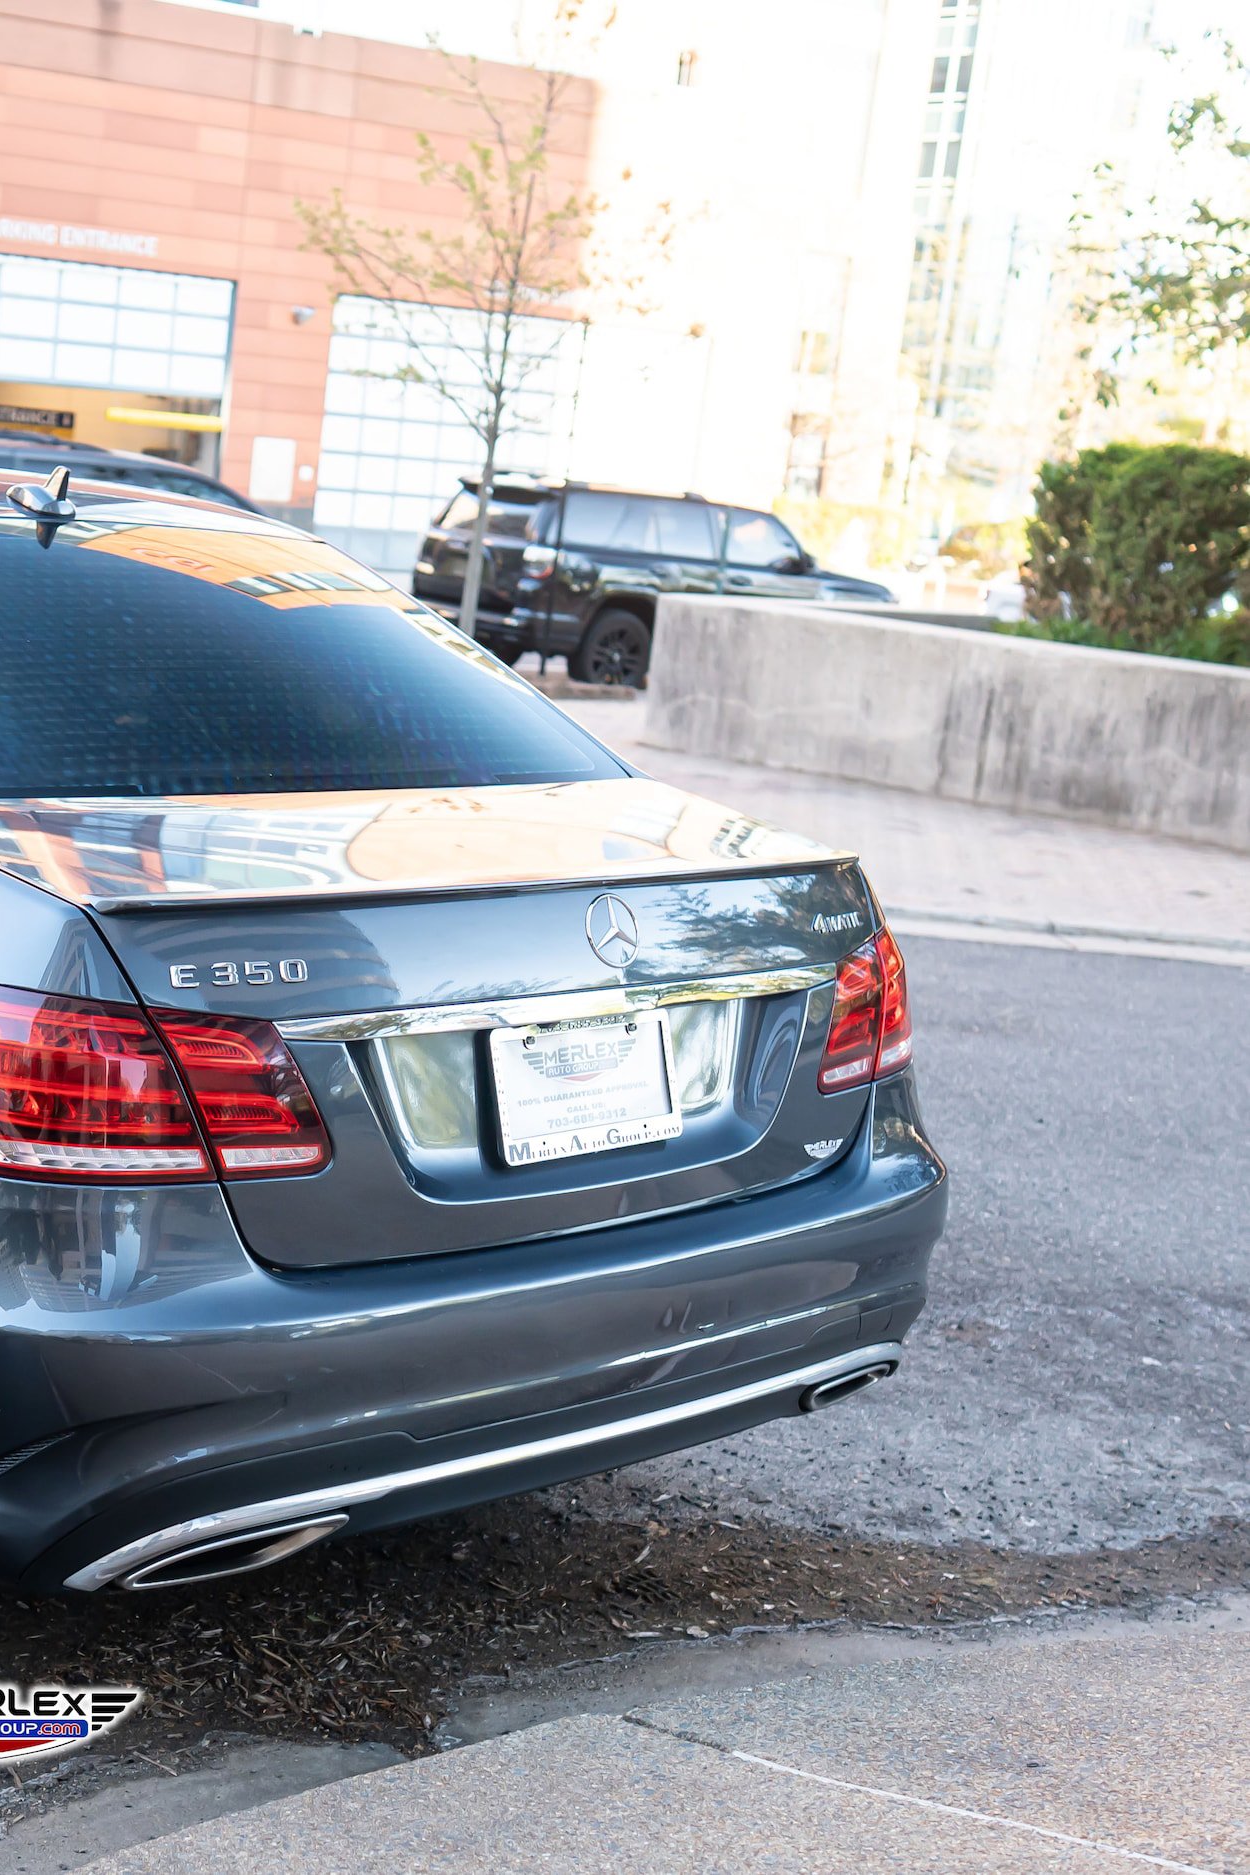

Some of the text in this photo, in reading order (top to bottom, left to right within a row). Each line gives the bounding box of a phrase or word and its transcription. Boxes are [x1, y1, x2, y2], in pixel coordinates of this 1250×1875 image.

[60, 225, 159, 257] ENTRANCE
[811, 911, 863, 934] 4MATIC
[169, 958, 308, 988] E 350
[544, 1042, 617, 1065] MERLEX
[548, 1061, 599, 1076] AUTO GROUP
[544, 1088, 603, 1103] GUARANTEED
[547, 1107, 627, 1129] 703-685-9312
[566, 1105, 589, 1113] CALL
